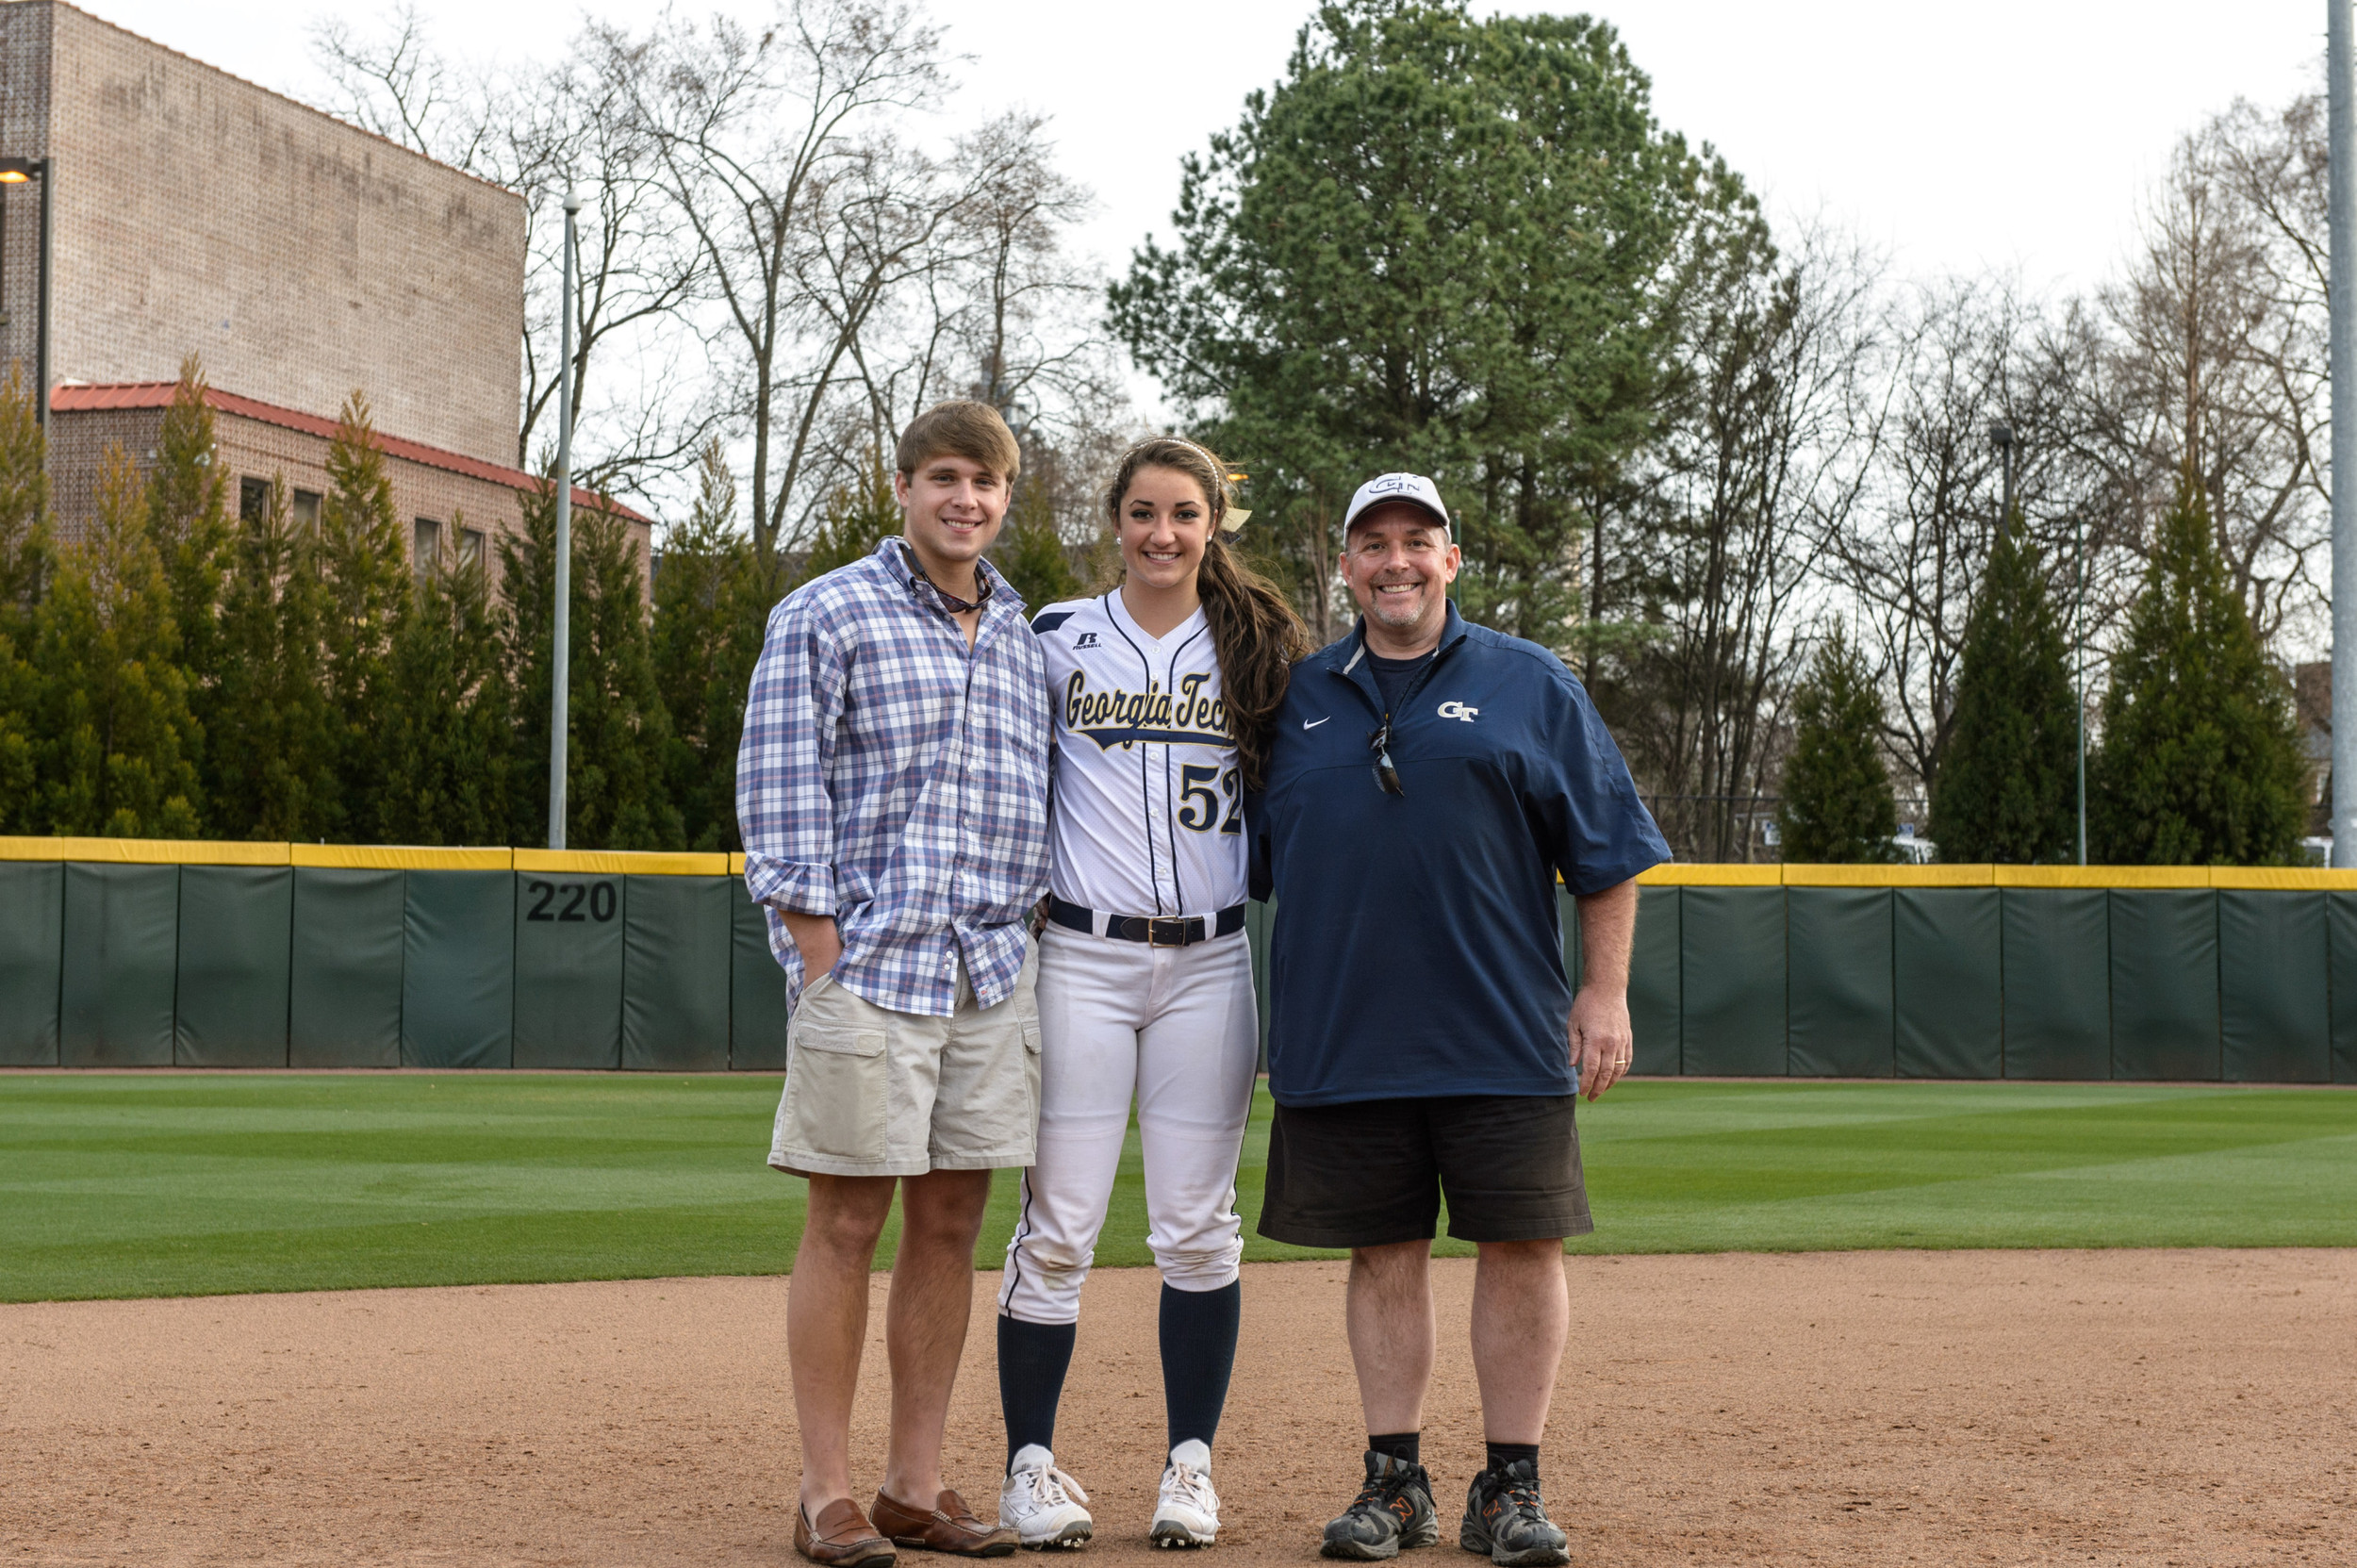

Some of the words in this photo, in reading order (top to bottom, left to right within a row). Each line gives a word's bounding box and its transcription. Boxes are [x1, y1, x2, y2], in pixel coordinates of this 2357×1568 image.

[1065, 668, 1173, 751] Georgia
[1175, 672, 1234, 740] Tec
[1437, 701, 1479, 723] GT
[1178, 763, 1243, 835] 52
[526, 880, 618, 922] 220
